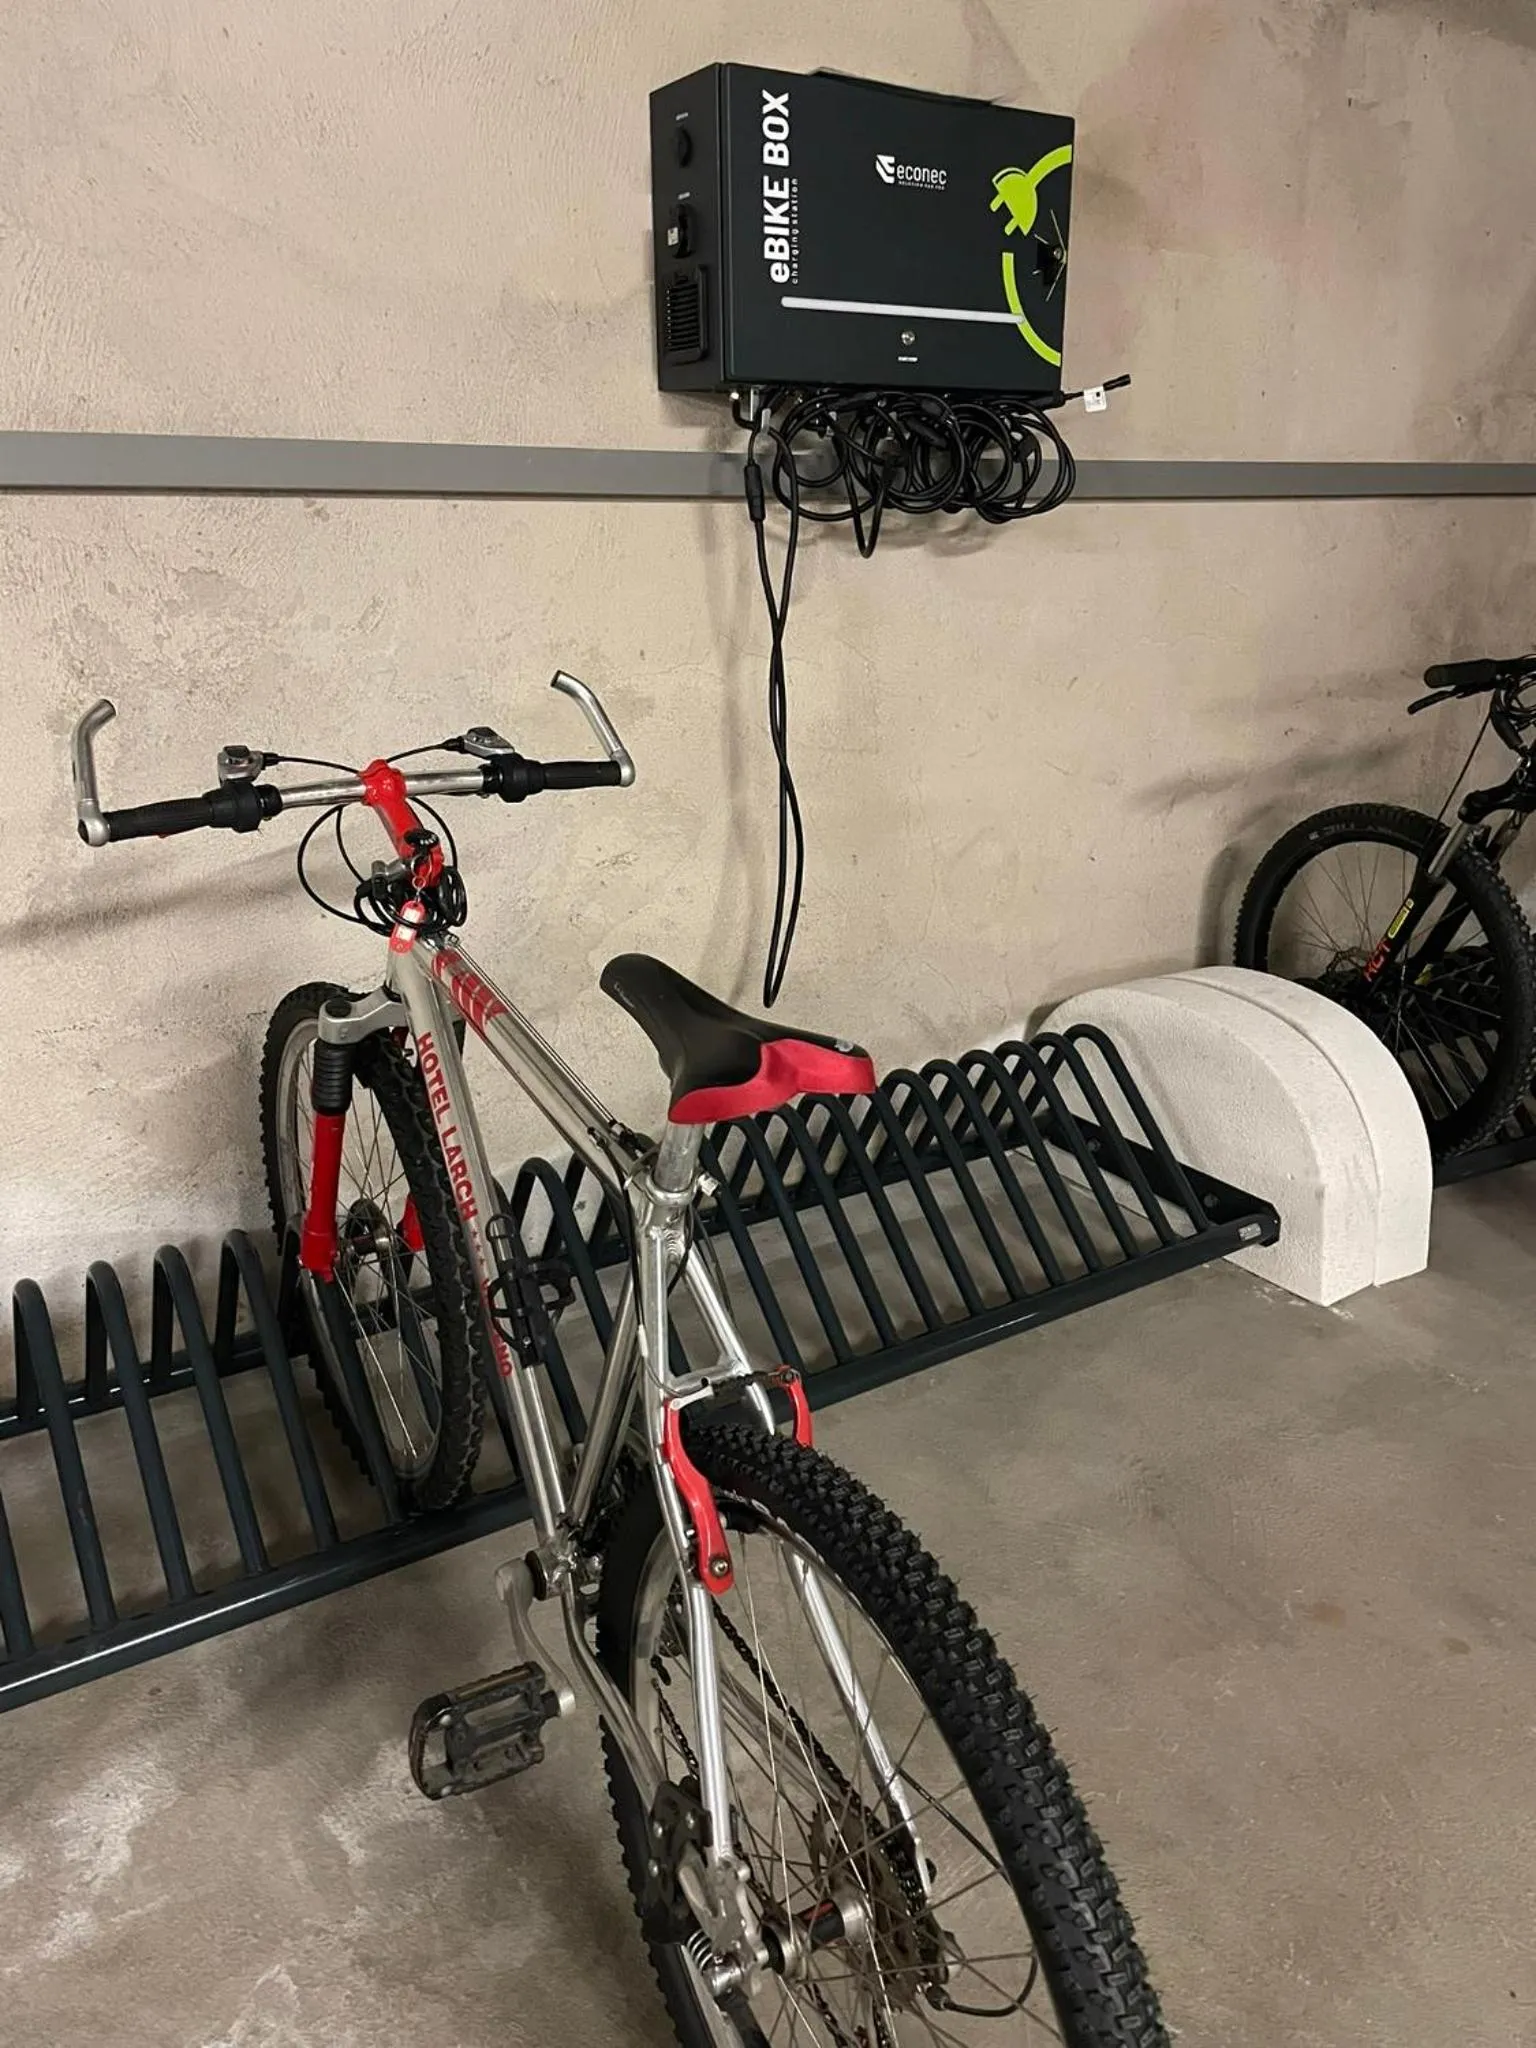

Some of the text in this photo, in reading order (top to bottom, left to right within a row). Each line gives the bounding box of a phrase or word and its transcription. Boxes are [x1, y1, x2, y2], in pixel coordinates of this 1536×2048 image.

[762, 88, 790, 284] eBIKE BOX
[791, 178, 800, 285] charging station
[896, 164, 947, 185] econec
[417, 1032, 478, 1222] HOTEL LARCH
